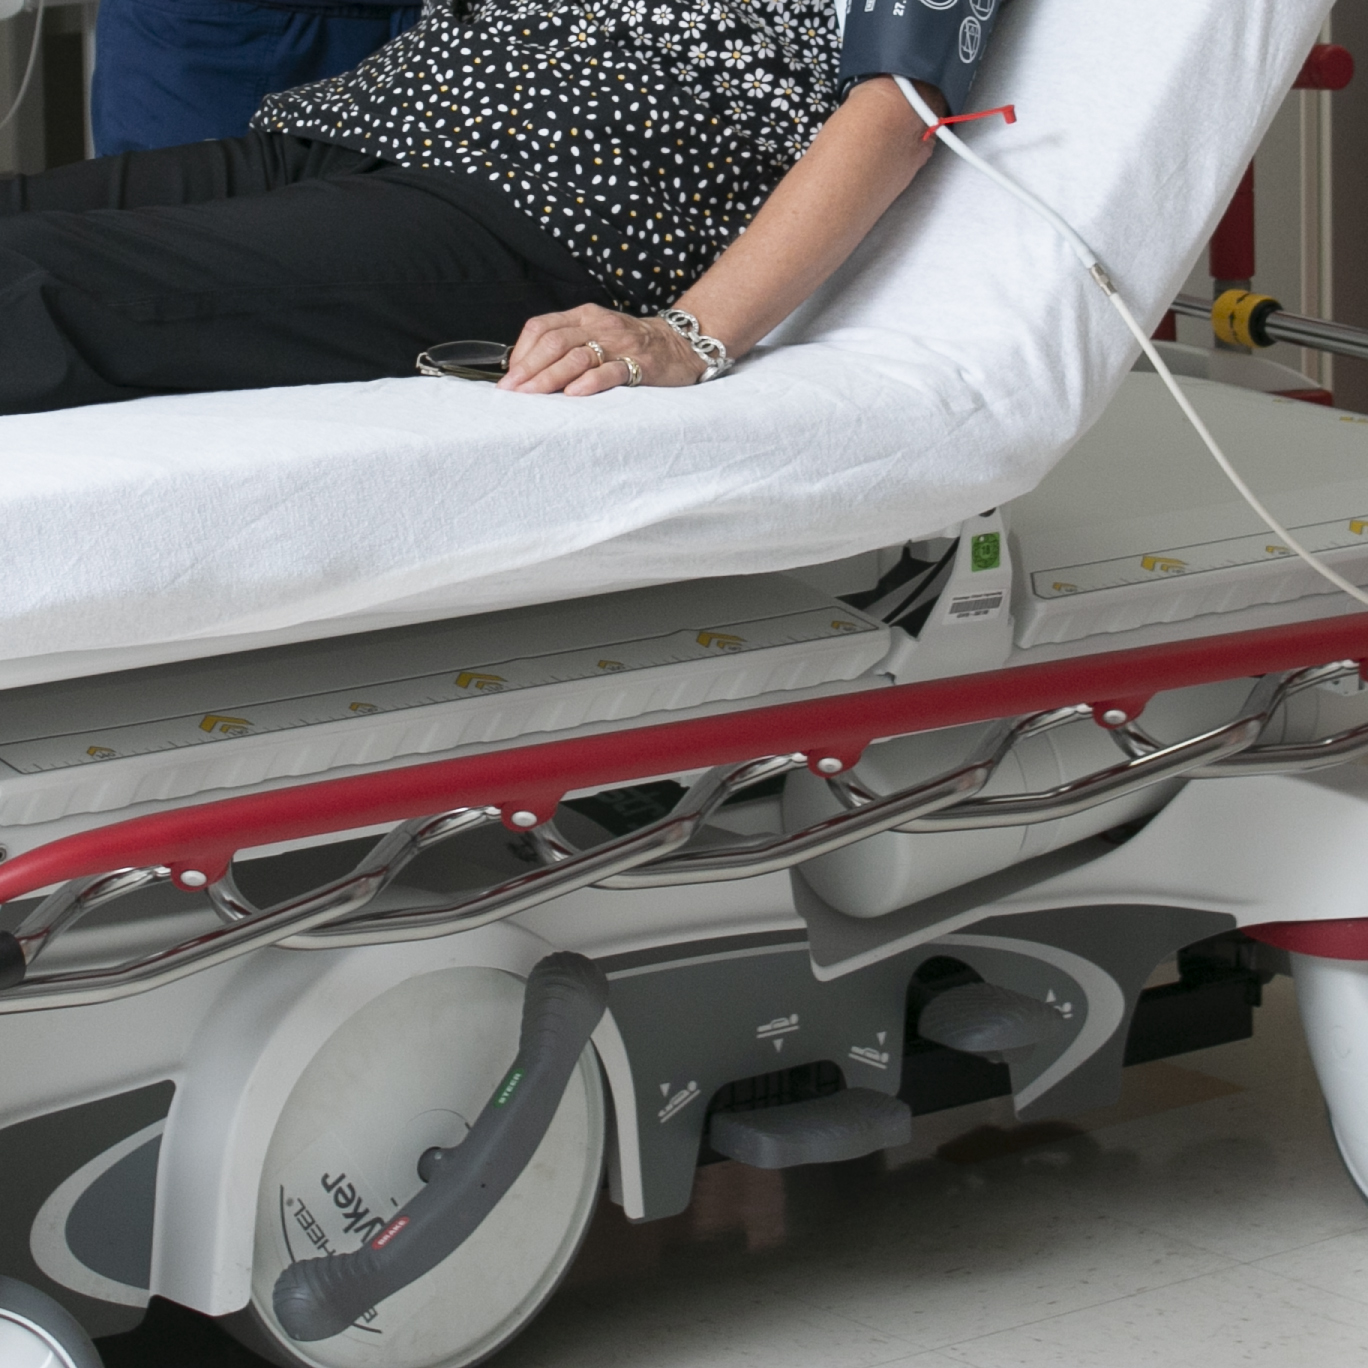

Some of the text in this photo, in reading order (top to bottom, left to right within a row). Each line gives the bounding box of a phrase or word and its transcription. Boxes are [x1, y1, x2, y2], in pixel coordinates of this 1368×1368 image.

[498, 1072, 523, 1104] STEER
[293, 1197, 337, 1256] HEEL
[320, 1172, 386, 1246] yker
[377, 1219, 406, 1245] BRAKE
